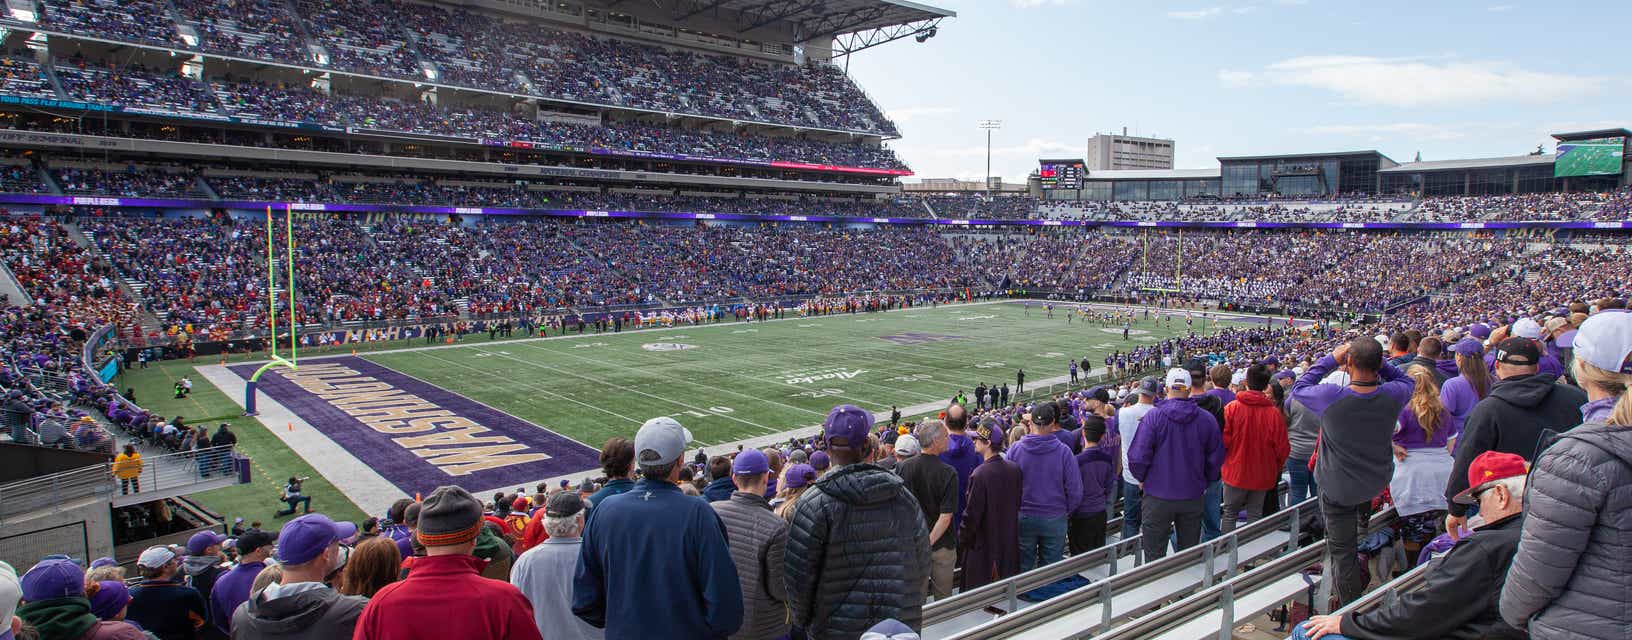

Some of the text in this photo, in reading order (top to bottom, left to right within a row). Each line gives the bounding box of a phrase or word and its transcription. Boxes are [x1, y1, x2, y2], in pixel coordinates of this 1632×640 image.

[74, 197, 98, 205] PURPLE
[785, 369, 869, 384] Alaska
[799, 388, 844, 398] 20
[681, 405, 735, 417] 10
[266, 363, 553, 477] WASHINGTON
